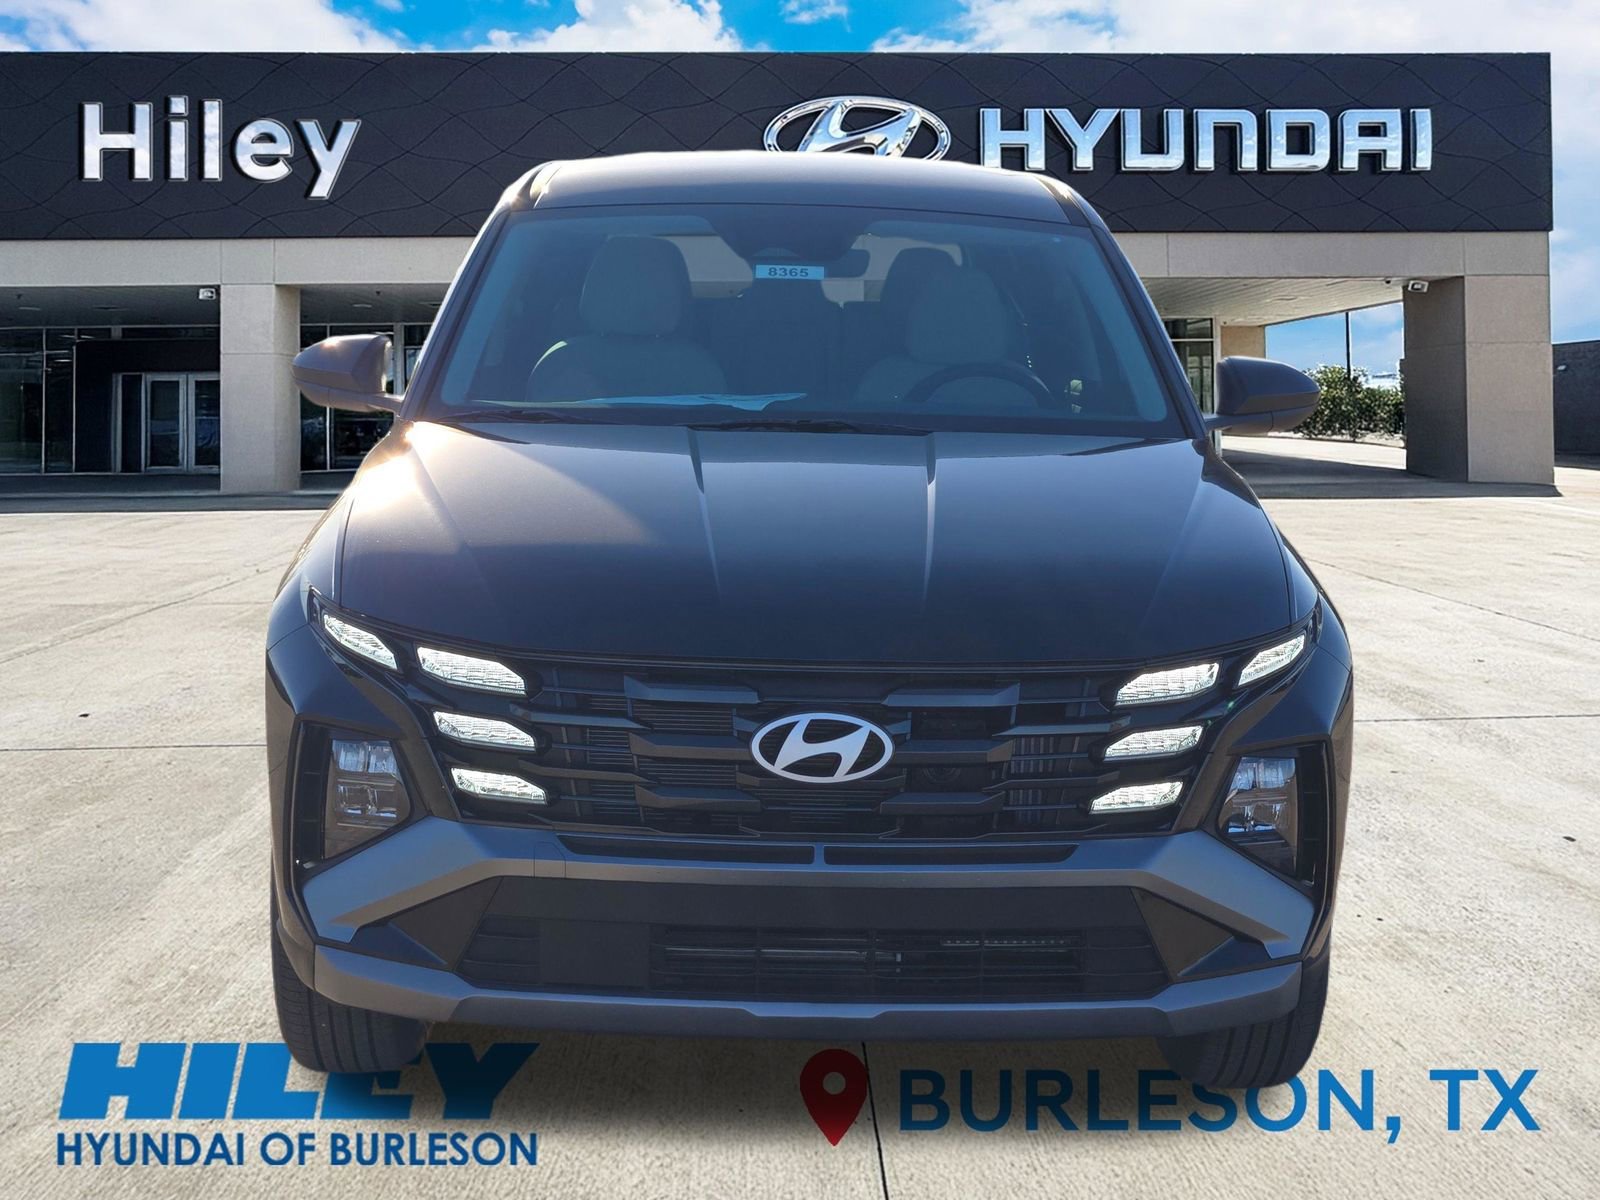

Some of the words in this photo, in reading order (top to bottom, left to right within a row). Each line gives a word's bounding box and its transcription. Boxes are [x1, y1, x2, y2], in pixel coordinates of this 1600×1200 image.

[80, 95, 362, 200] Hiley
[980, 107, 1433, 172] HYUNDAI
[767, 266, 810, 278] 8365
